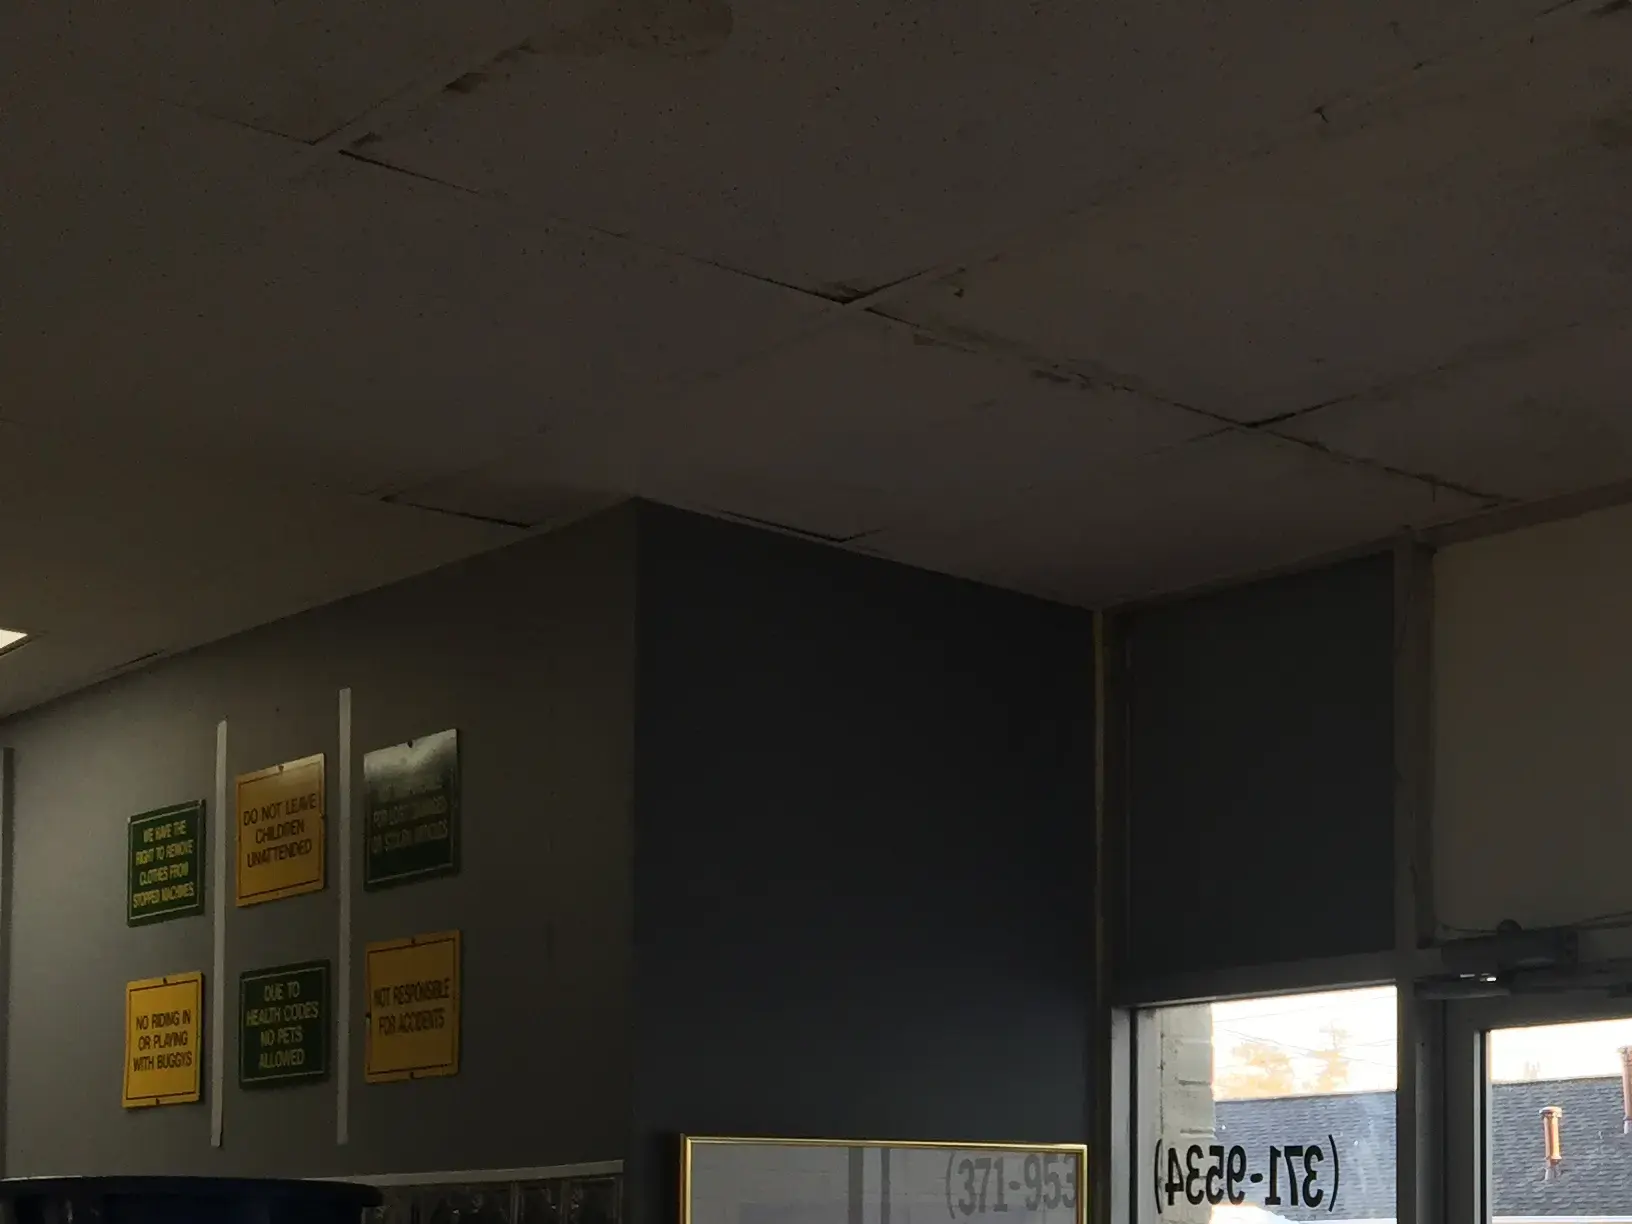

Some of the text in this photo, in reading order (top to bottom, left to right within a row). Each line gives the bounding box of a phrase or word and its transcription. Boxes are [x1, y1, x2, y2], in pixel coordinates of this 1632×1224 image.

[243, 793, 316, 826] DO NOT LEAVE
[256, 819, 305, 844] CHILDREN
[156, 845, 165, 860] TO
[247, 839, 312, 868] UNATTENDED
[264, 981, 300, 1002] DUE TO
[393, 978, 450, 1005] RESPONSIBLE
[136, 1008, 192, 1030] NO RIDING IN
[246, 1001, 319, 1026] HEALTH CODES
[379, 1015, 396, 1036] FOR
[138, 1030, 188, 1051] OR PLAYING
[260, 1026, 303, 1048] NO PETS
[133, 1050, 193, 1072] WITH BUGGYS
[259, 1047, 305, 1069] ALLOWED
